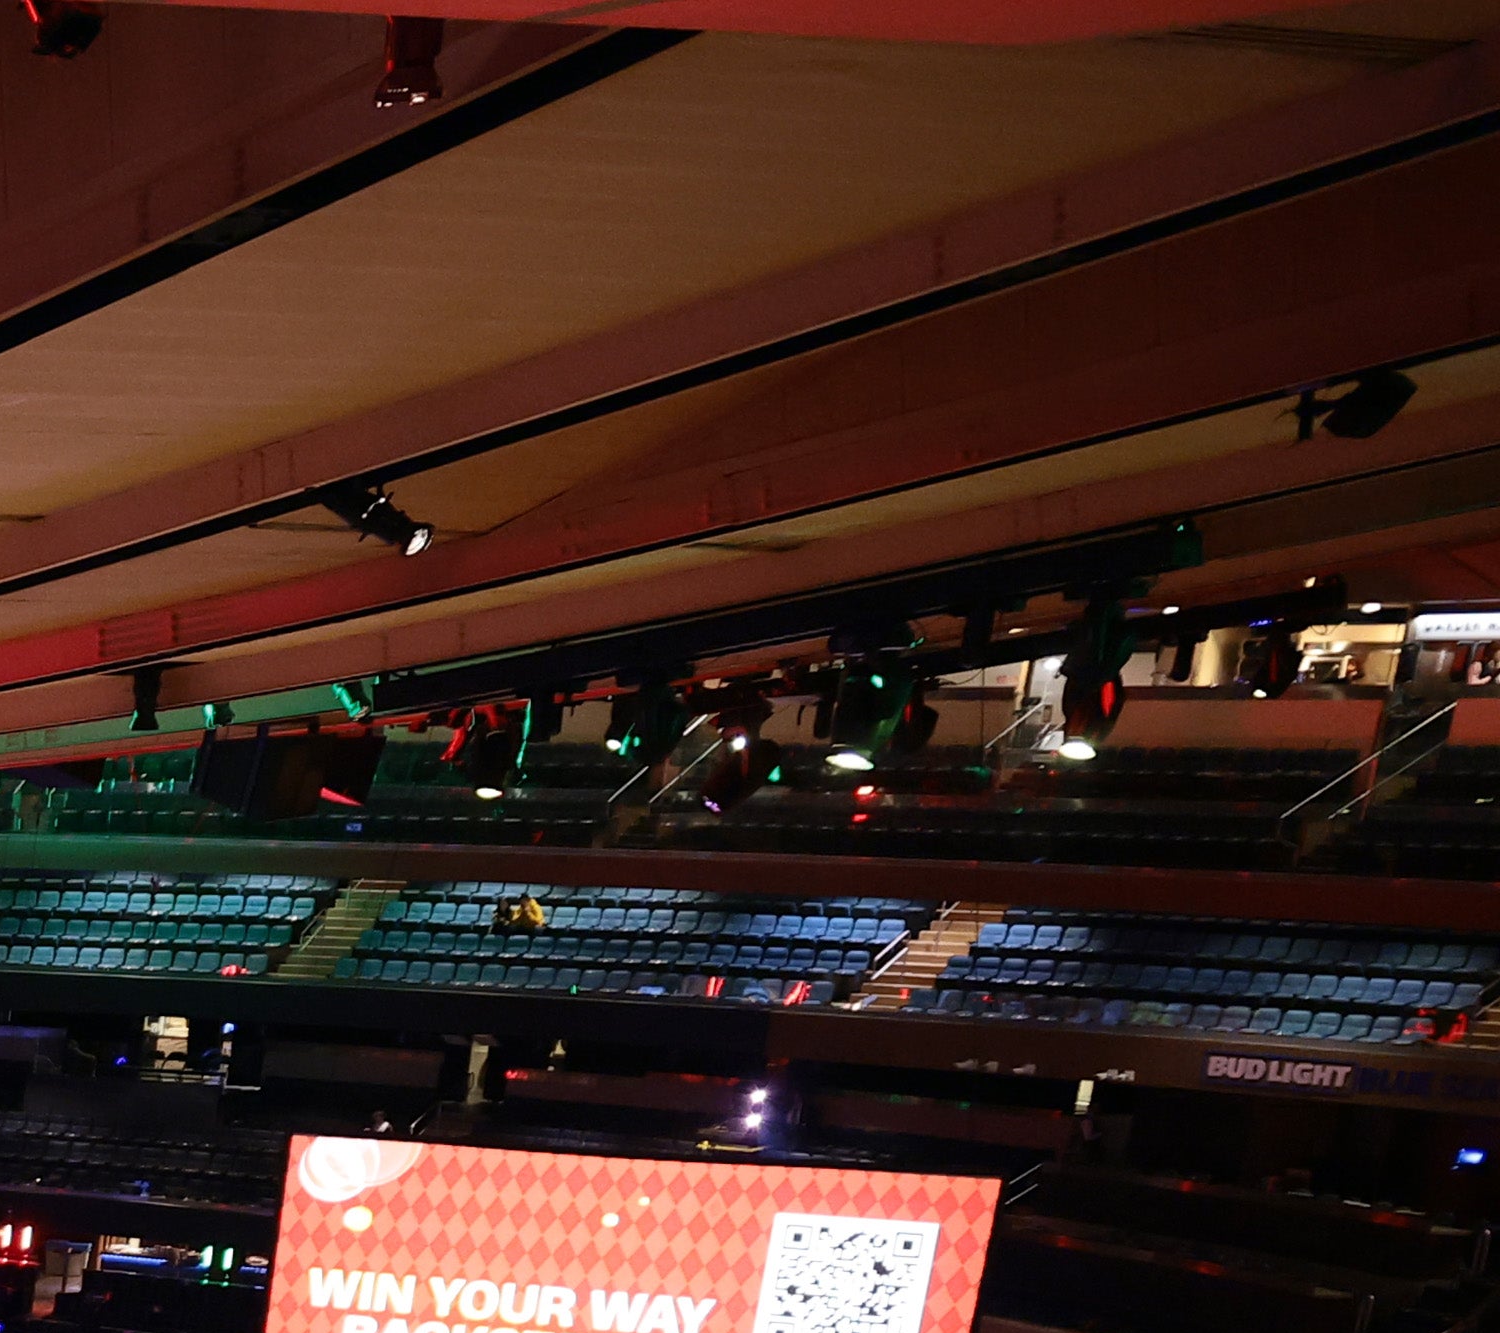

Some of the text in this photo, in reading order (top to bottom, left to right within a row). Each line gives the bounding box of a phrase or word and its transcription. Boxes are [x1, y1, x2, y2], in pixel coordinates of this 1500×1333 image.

[1206, 1055, 1267, 1081] BUD
[1267, 1061, 1353, 1088] LIGHT
[307, 1267, 417, 1315] WIN
[432, 1278, 576, 1330] YOUR
